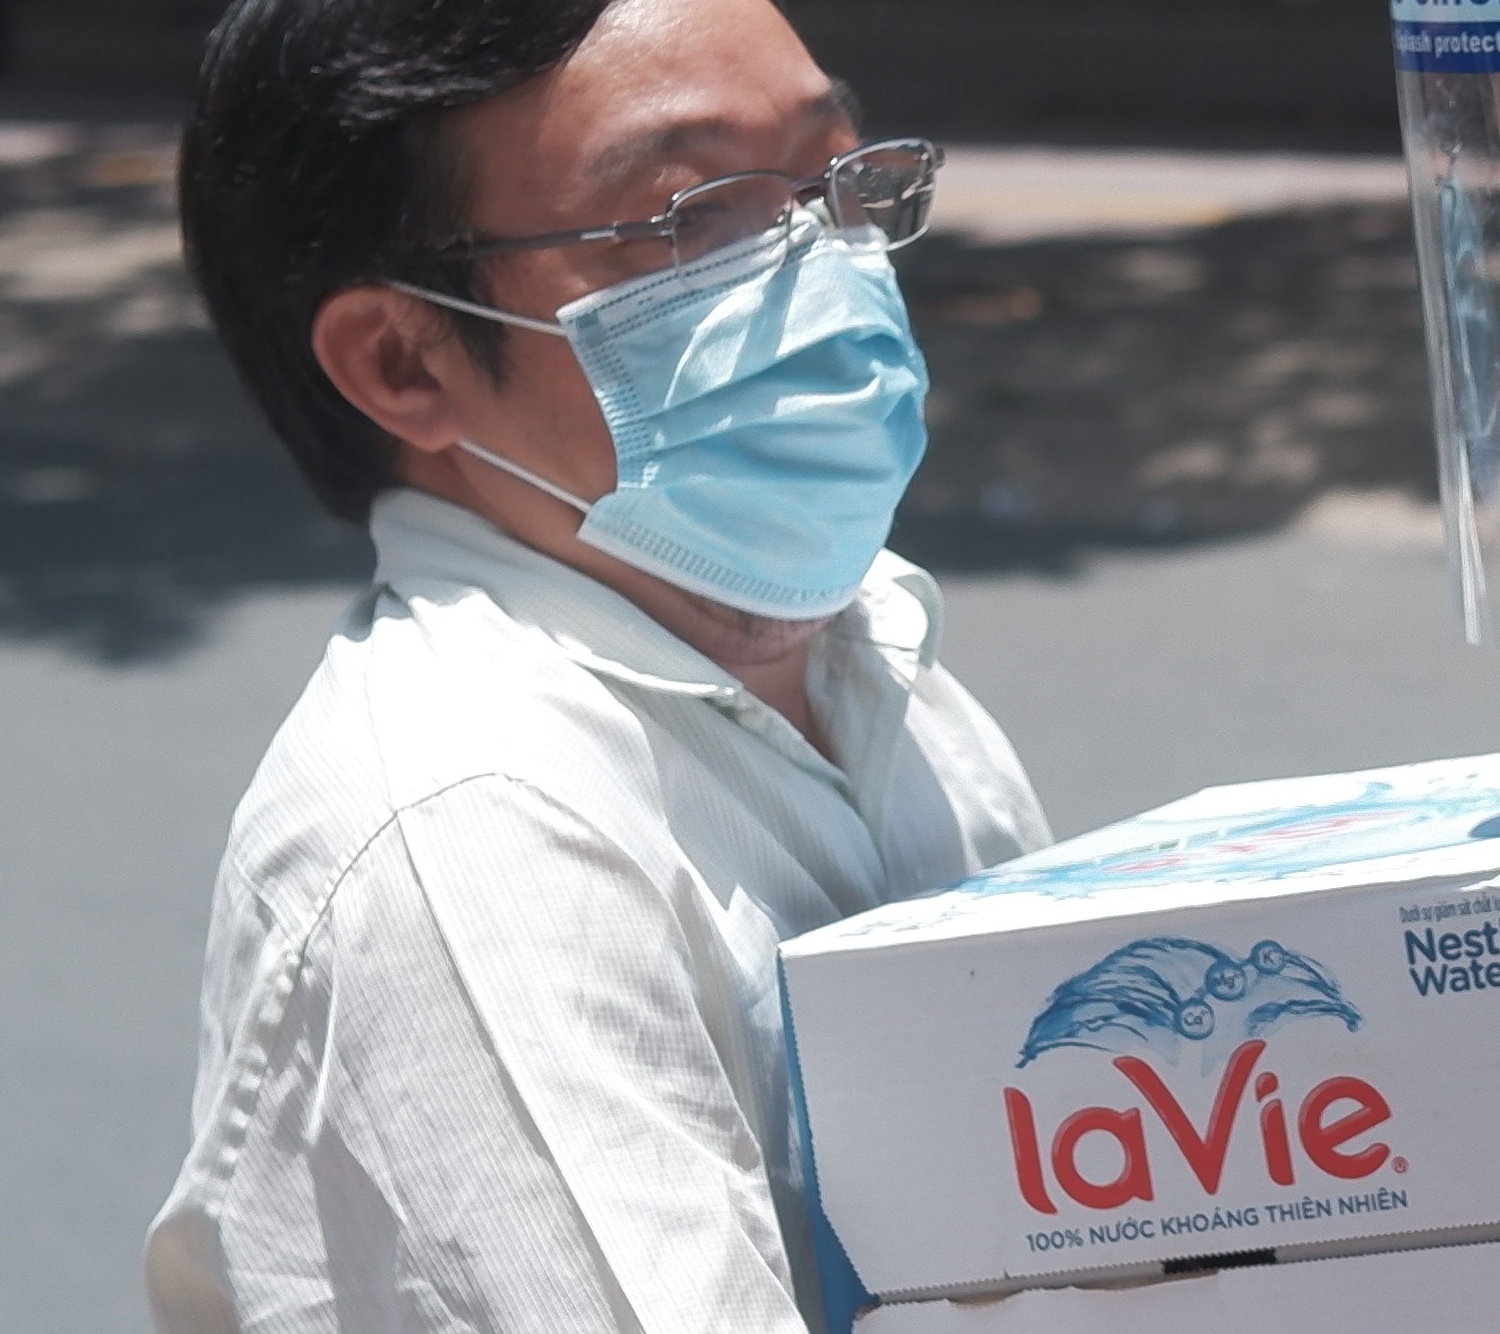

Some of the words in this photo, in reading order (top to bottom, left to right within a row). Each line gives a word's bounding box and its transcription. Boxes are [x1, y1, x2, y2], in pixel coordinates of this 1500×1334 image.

[1003, 1038, 1391, 1215] laVie
[1026, 1226, 1084, 1253] 100%
[1088, 1211, 1156, 1245] NƯỚC
[1160, 1203, 1260, 1237] KHOÁNG
[1264, 1192, 1332, 1225] THIÊN
[1339, 1186, 1409, 1216] NHIÊN
